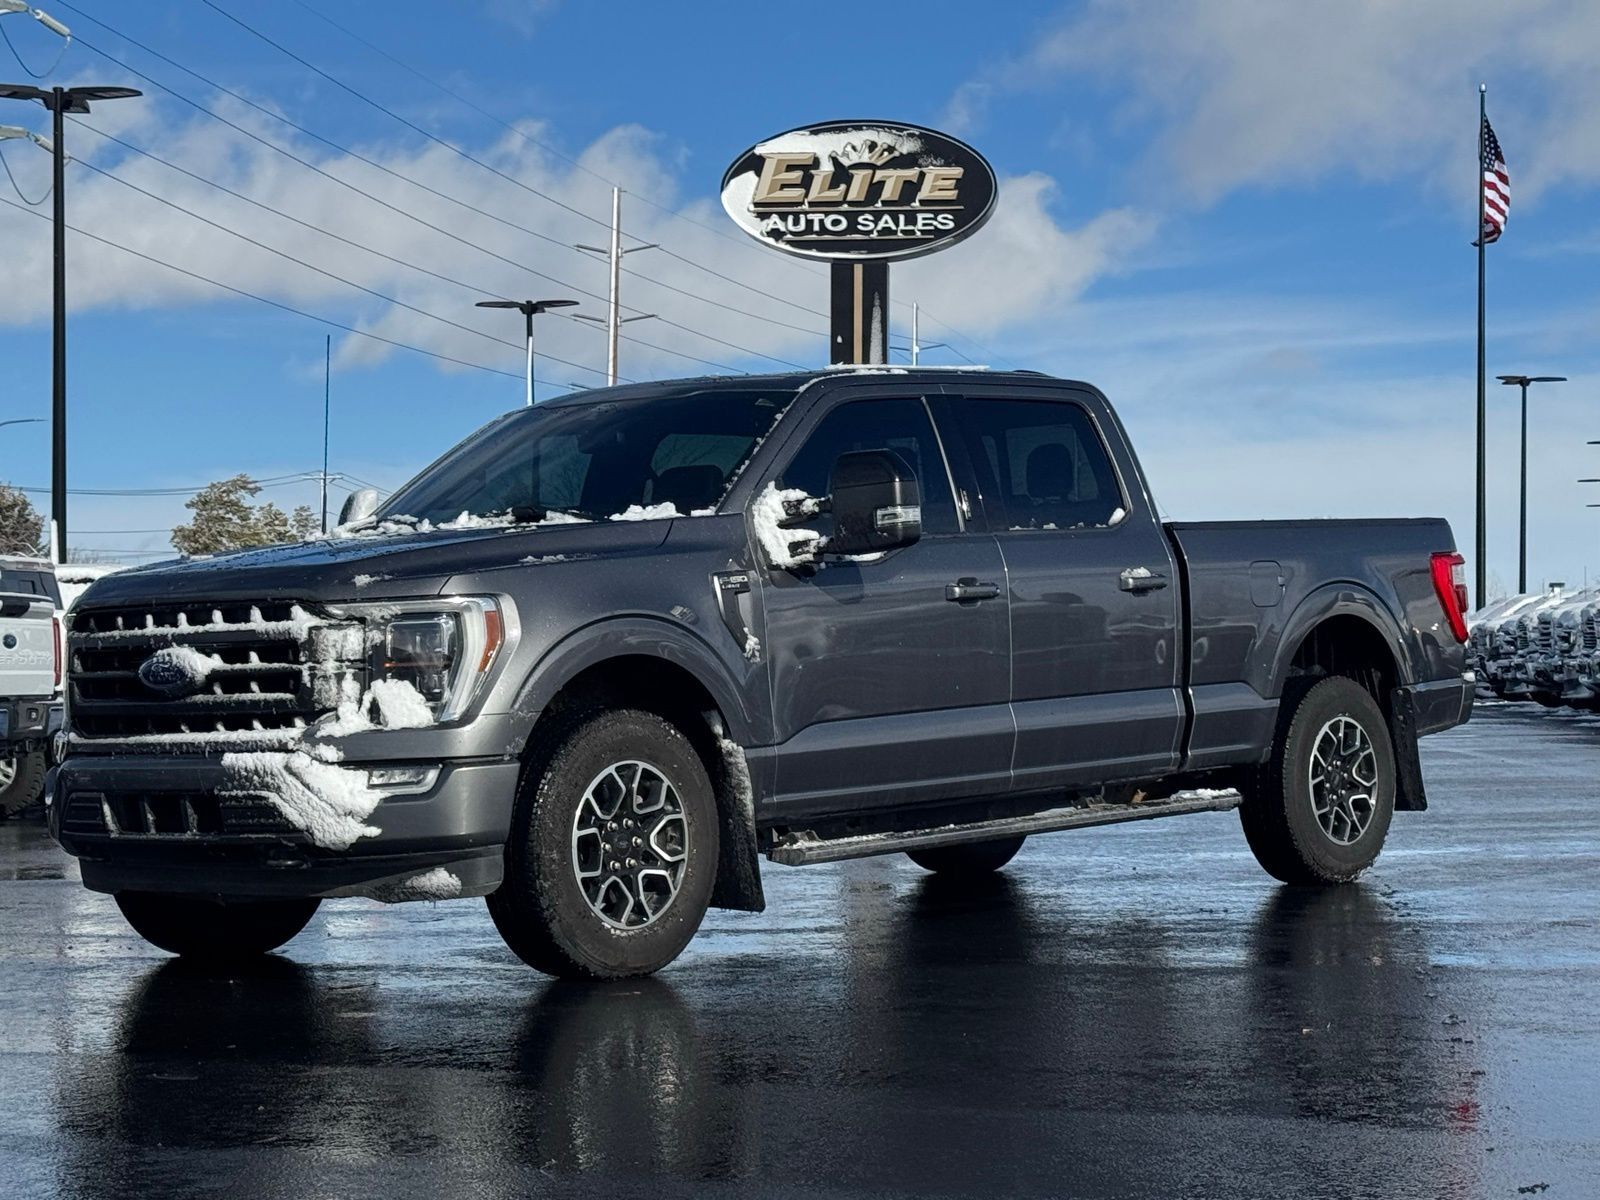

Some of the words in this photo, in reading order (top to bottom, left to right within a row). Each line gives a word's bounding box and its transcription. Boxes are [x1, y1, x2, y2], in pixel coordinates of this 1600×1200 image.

[754, 152, 964, 203] ELITE
[765, 213, 848, 232] AUTO
[857, 212, 955, 232] SALES
